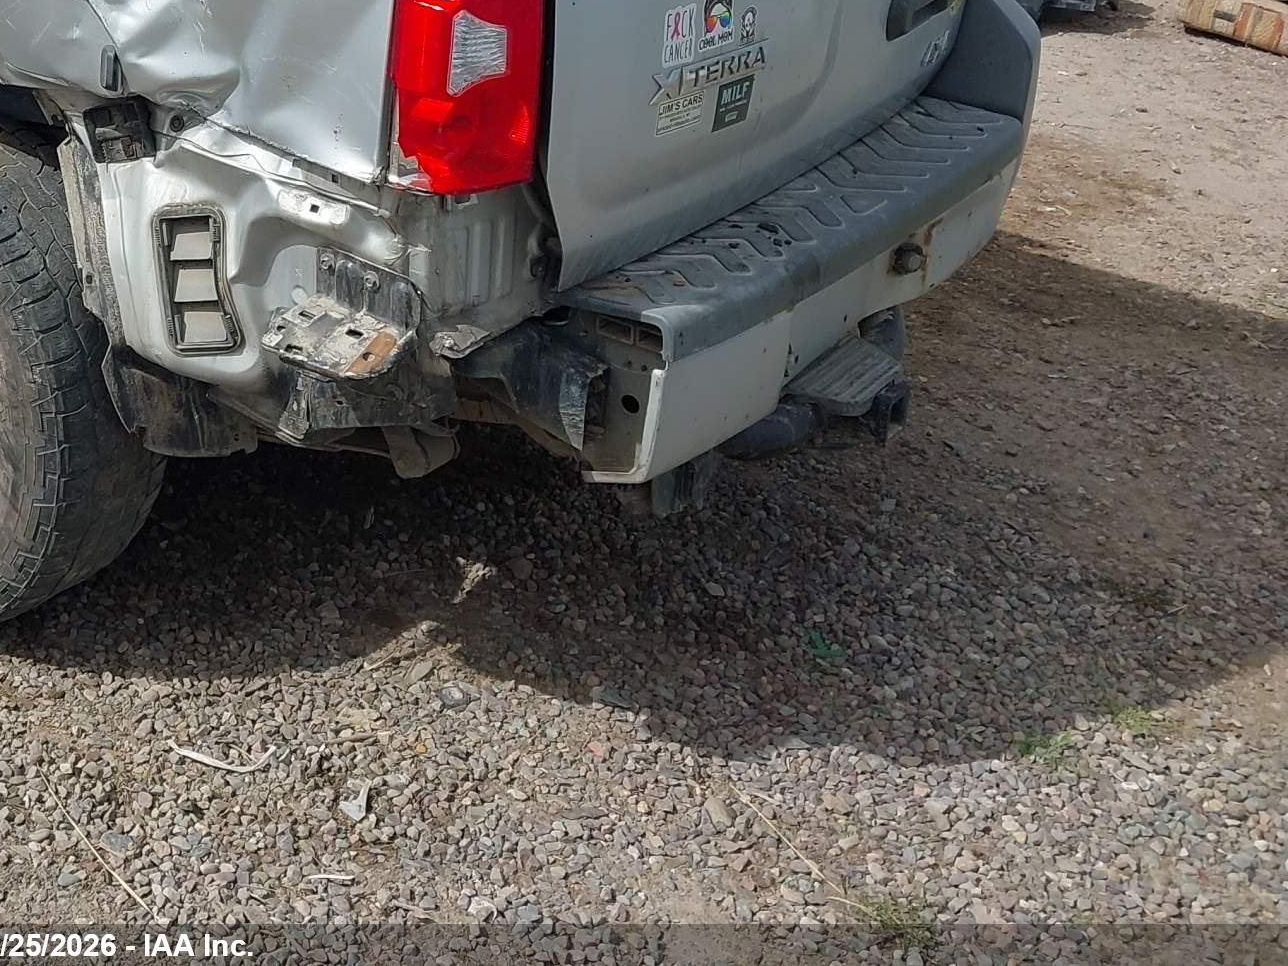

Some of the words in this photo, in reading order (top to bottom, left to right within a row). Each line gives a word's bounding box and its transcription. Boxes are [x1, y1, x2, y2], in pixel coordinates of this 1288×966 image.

[649, 46, 767, 105] XTERRA
[660, 101, 680, 115] JIM'S
[682, 94, 703, 109] CARS
[721, 81, 751, 105] MILF
